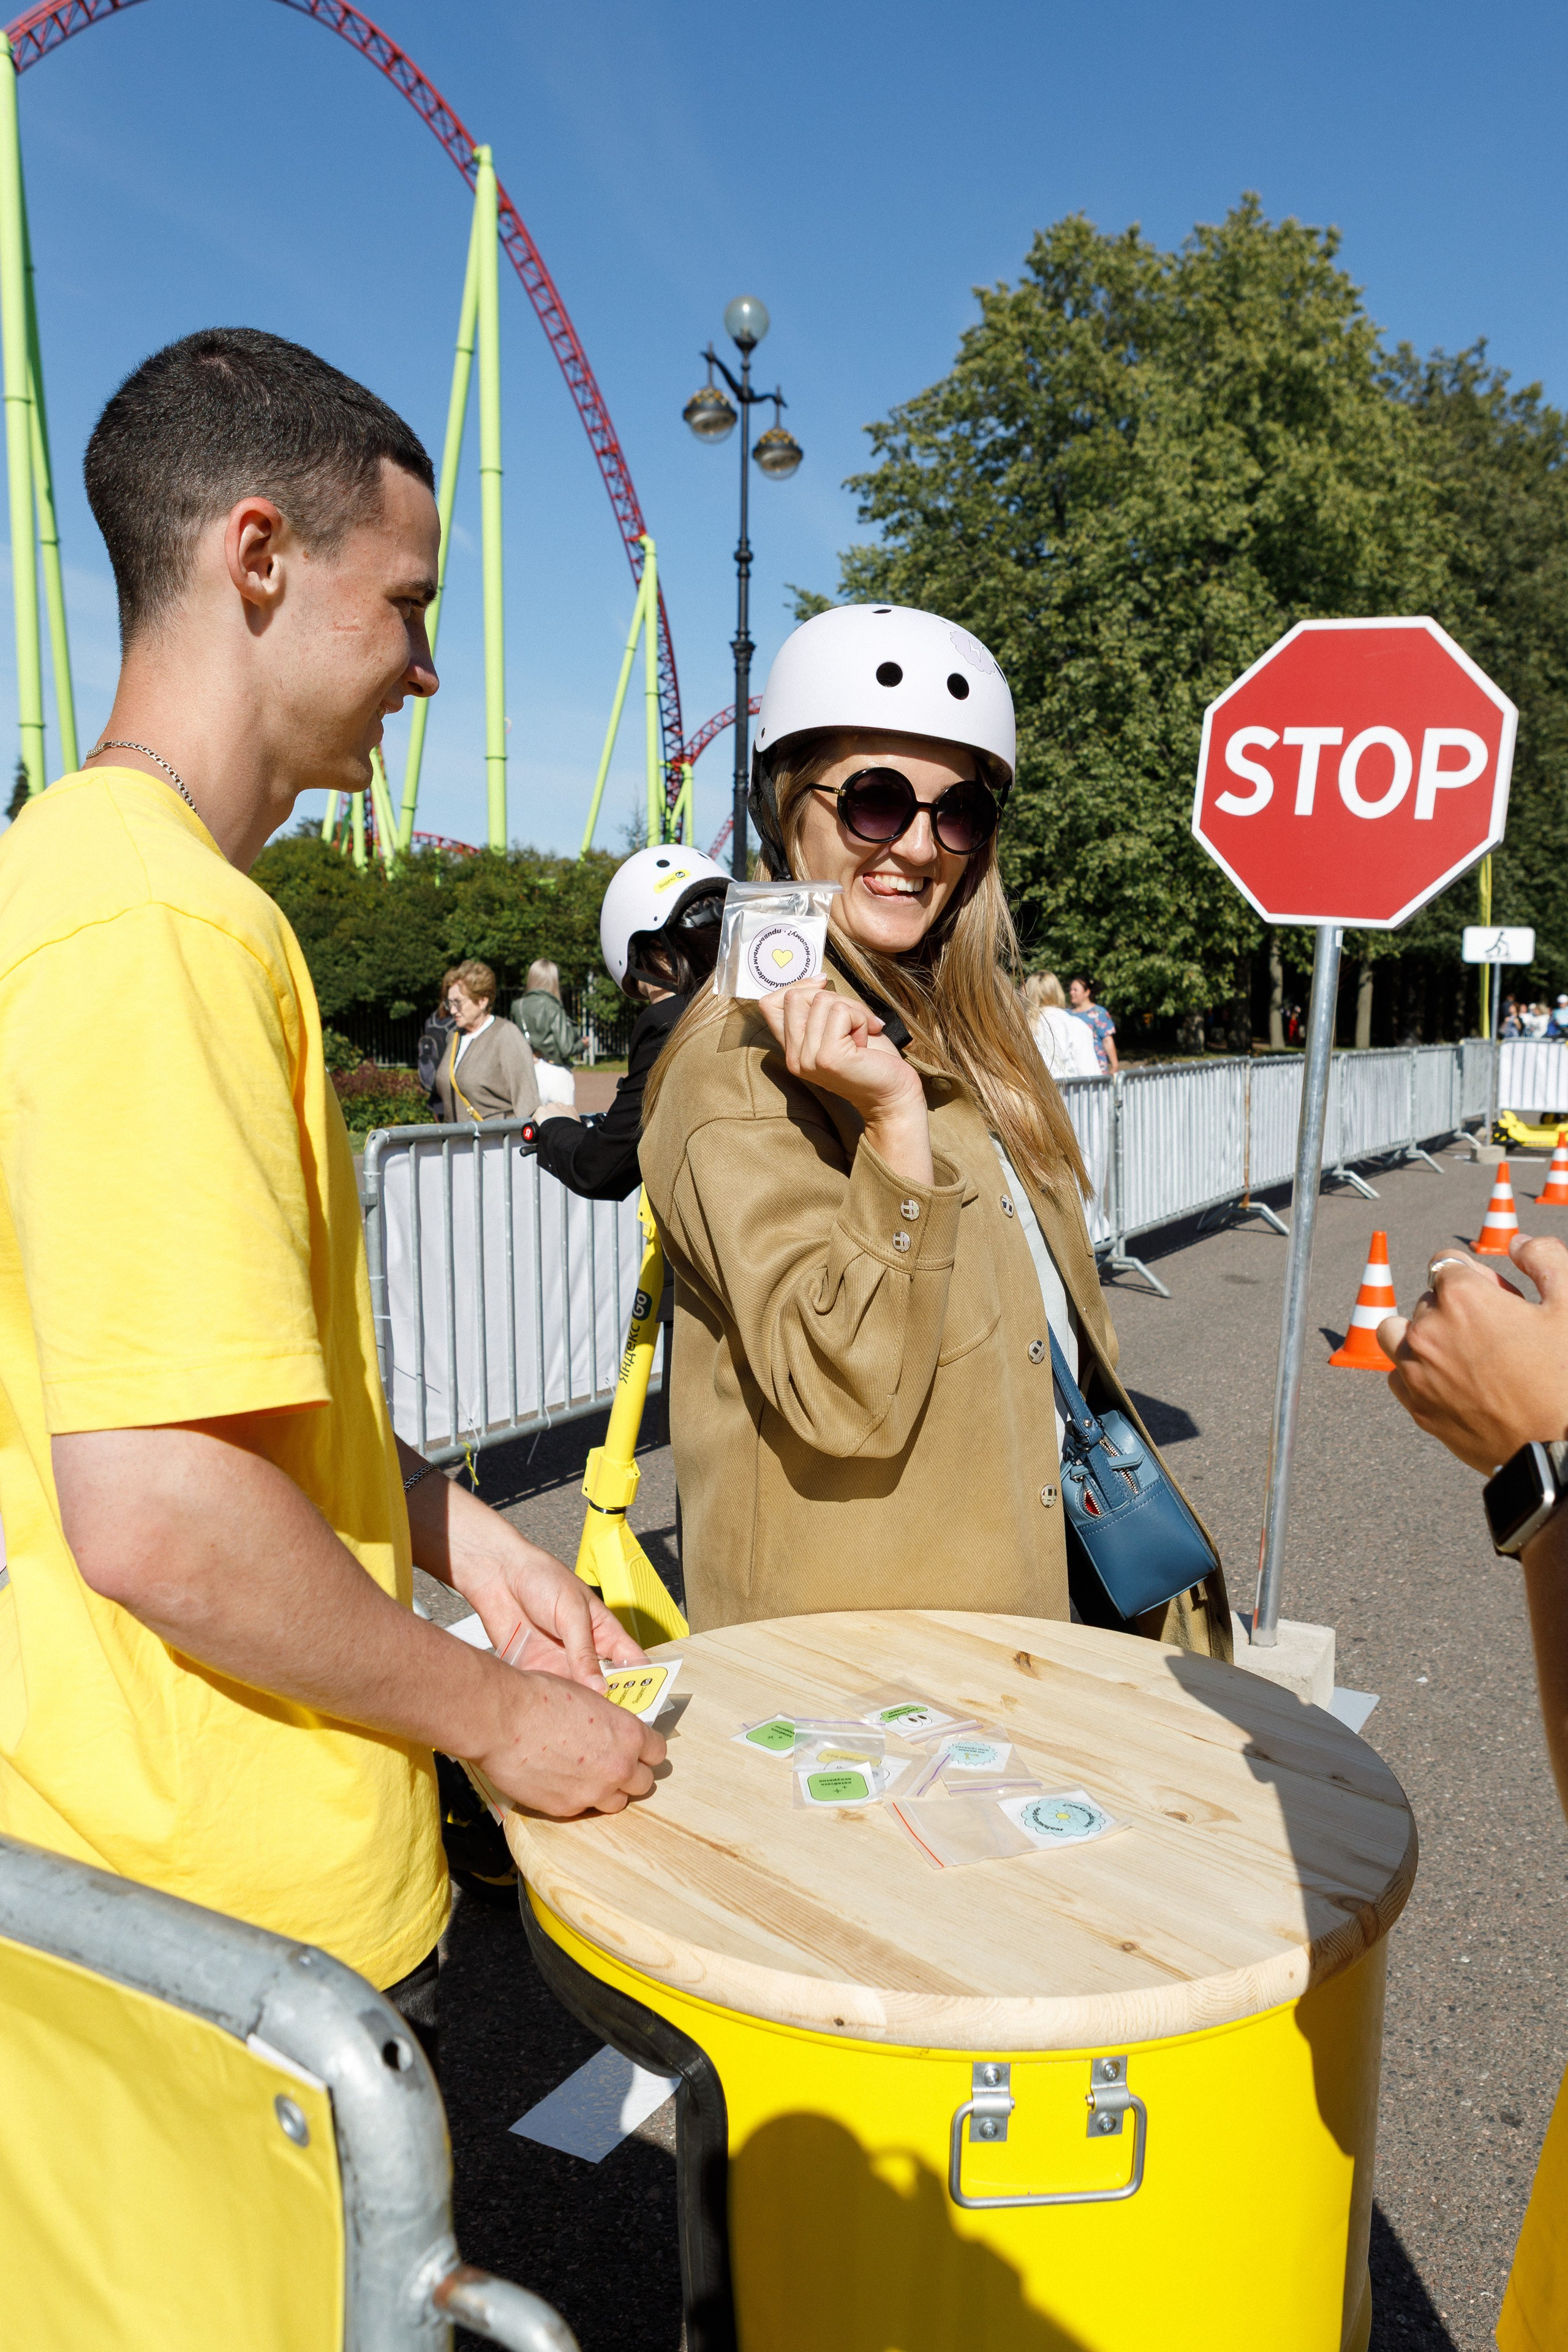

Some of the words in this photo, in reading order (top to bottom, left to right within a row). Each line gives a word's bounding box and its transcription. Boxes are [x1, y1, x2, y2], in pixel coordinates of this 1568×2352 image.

[1215, 725, 1488, 820] STOP
[658, 876, 676, 889] Яндекс
[753, 929, 782, 965] привычным
[797, 968, 808, 981] или
[619, 1322, 640, 1384] Яндекс
